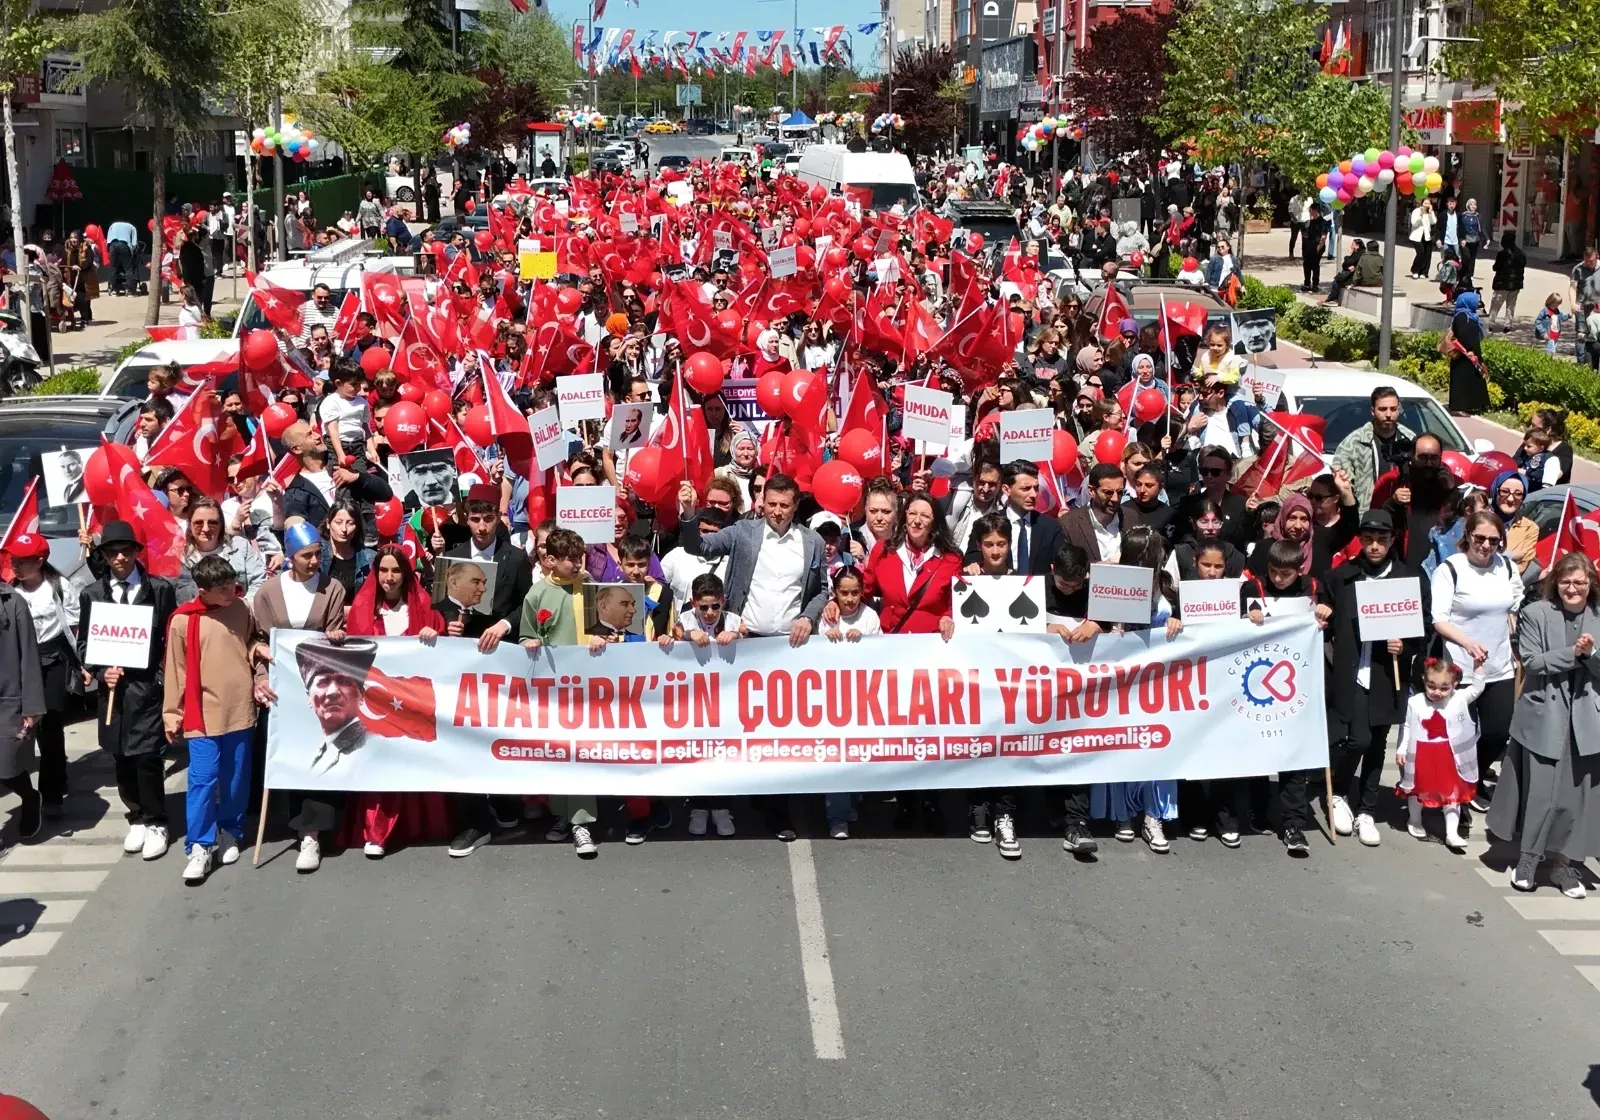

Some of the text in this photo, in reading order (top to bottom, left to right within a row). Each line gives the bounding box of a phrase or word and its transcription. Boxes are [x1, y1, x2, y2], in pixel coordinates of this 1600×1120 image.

[1244, 377, 1281, 393] ADLETE
[560, 390, 602, 400] ADALETE
[905, 400, 949, 420] UMUDA
[534, 422, 560, 445] BİLİME
[949, 426, 963, 435] İĞE
[1002, 427, 1052, 440] ADALETE
[560, 506, 613, 519] GELECEĞE
[1091, 584, 1149, 598] ÖZGÜRLÜĞE
[1183, 601, 1237, 613] ÖZGÜRLÜĞE
[1361, 598, 1419, 614] GELECEĞE
[91, 624, 148, 640] SANATA
[1228, 643, 1309, 676] ÇERKEZKÖY
[453, 655, 1210, 733] ATATÜRK'ÜN ÇOCUKLARI YÜRÜYOR!
[1260, 729, 1283, 738] 1911
[498, 725, 1164, 763] sanata adalete eşitliğe geleceğe aydınlığa ışığa milli egemenliğe
